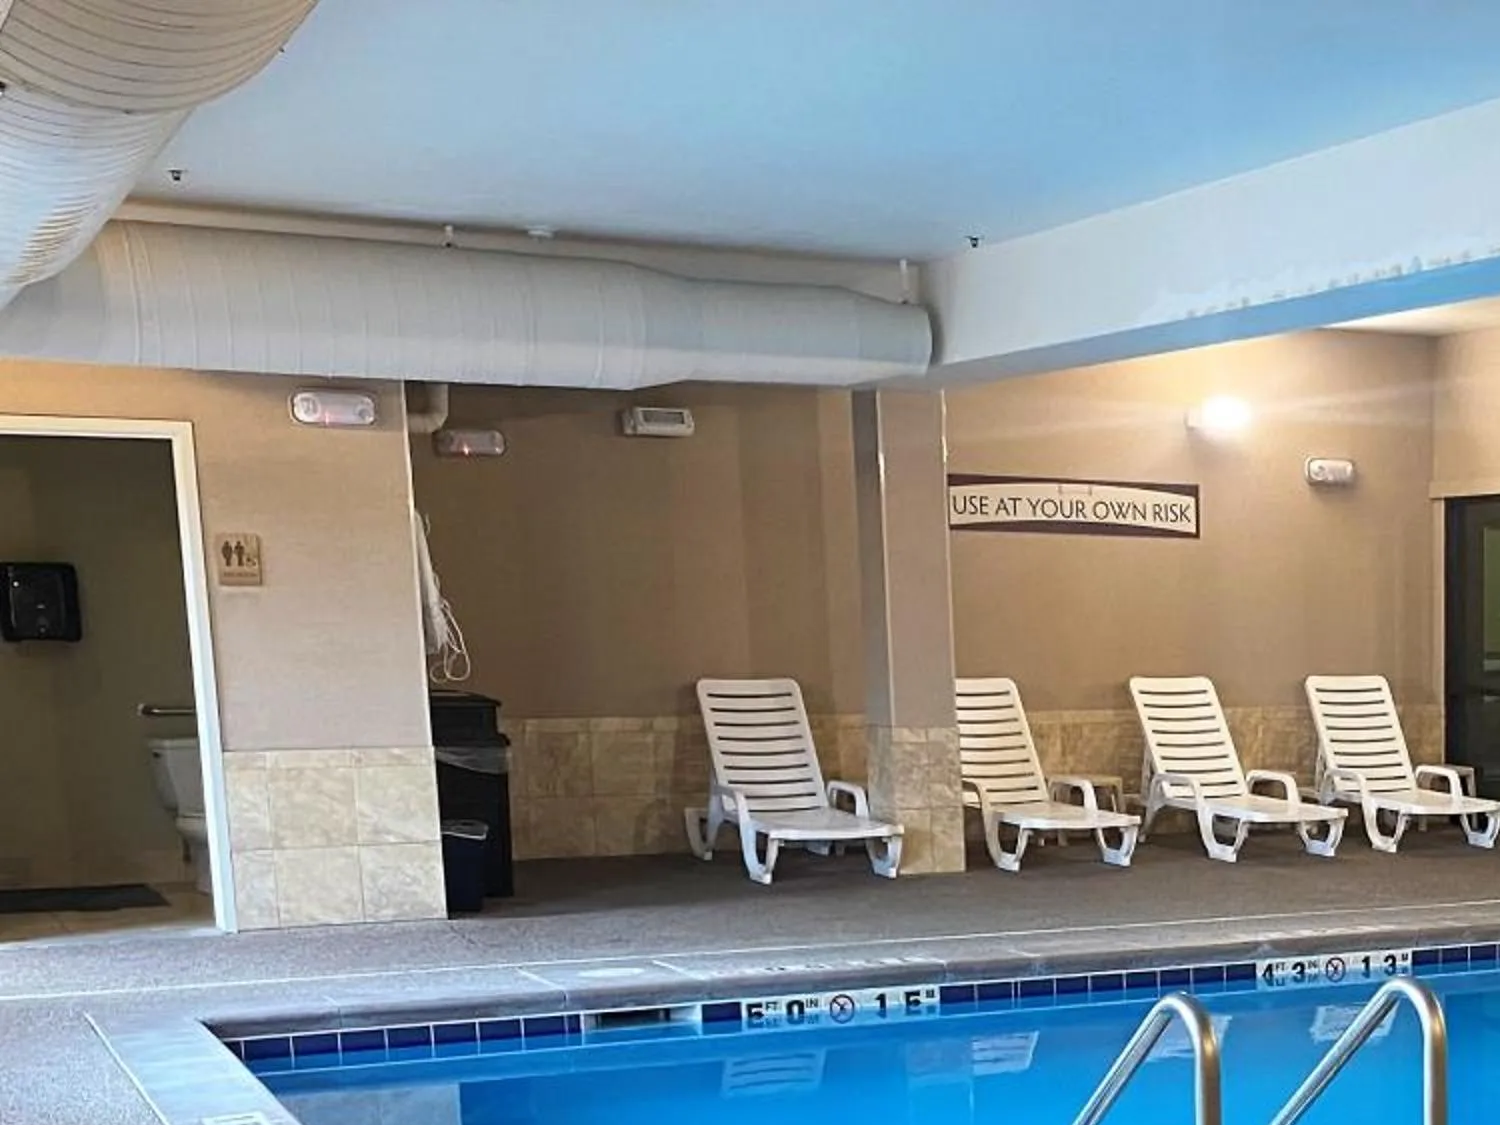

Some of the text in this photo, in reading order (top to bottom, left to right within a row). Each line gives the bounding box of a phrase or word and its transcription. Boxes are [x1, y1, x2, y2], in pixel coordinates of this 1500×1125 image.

[952, 495, 1192, 523] USE AT YOUR OWN RISK
